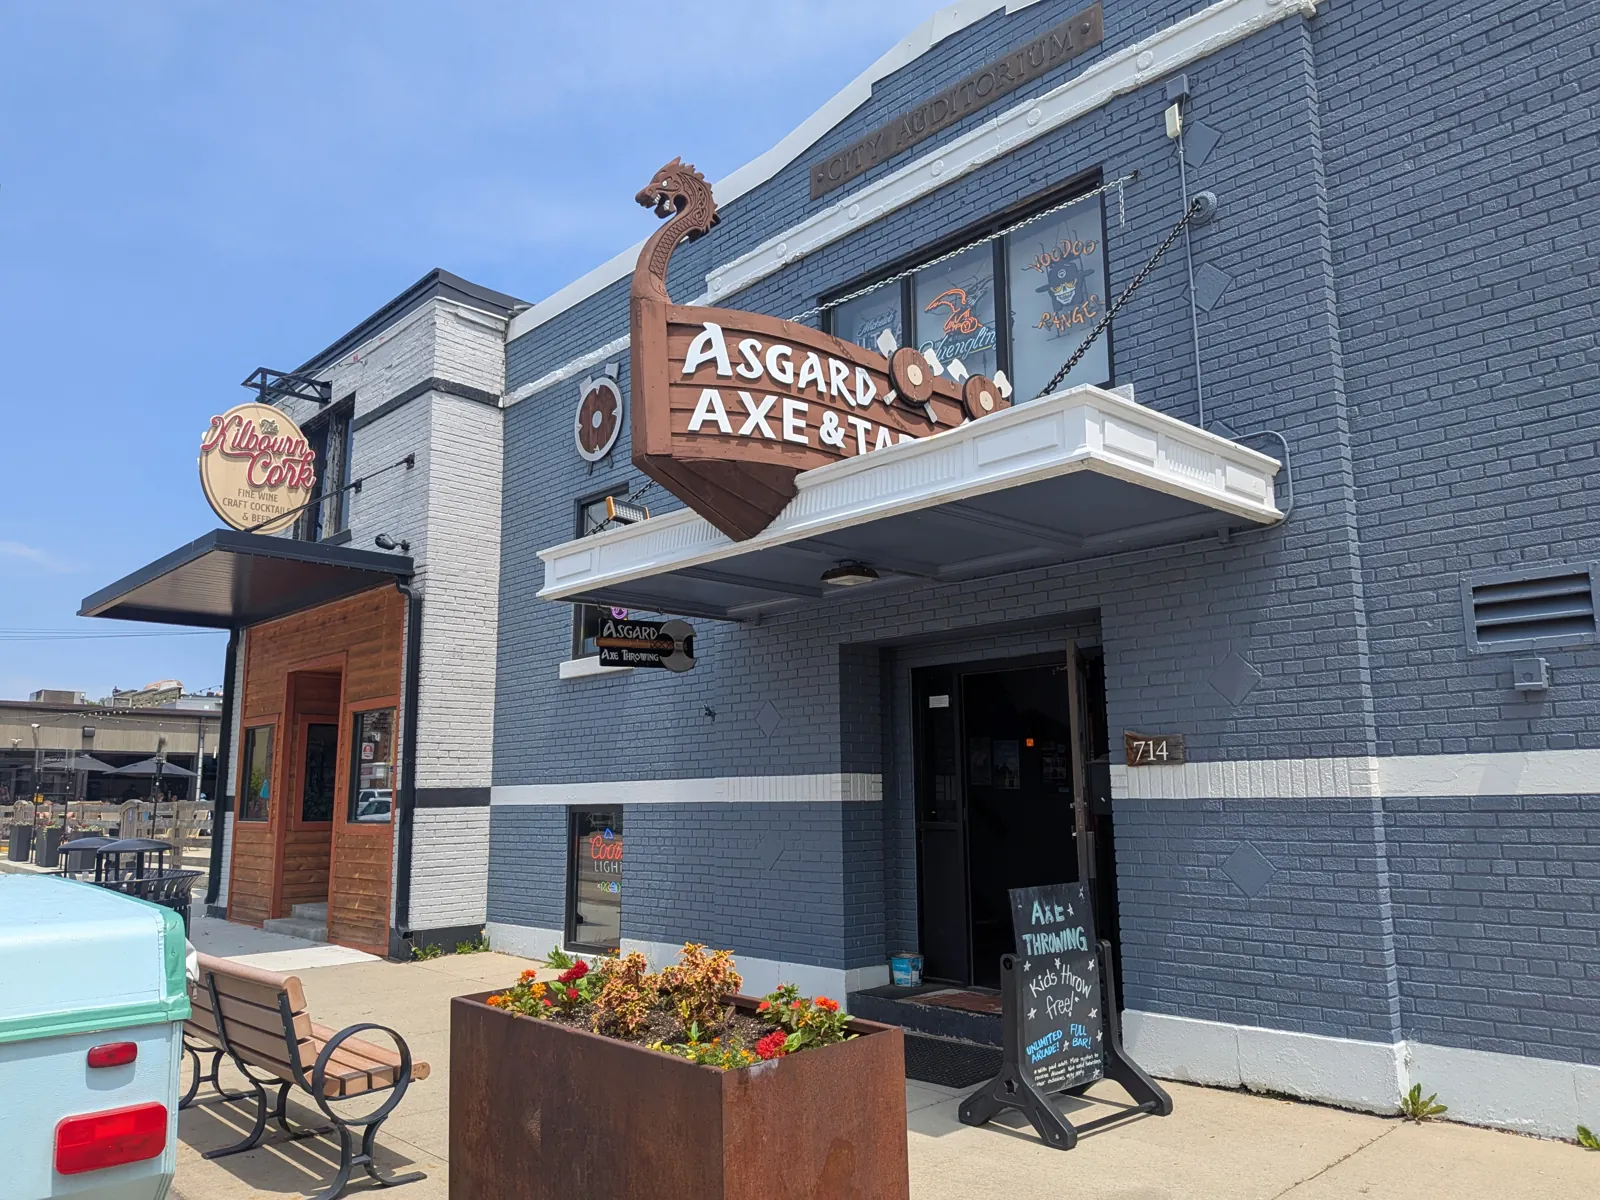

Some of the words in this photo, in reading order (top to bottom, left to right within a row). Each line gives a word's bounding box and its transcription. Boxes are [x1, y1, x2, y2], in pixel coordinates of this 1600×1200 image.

[827, 132, 883, 181] CITY
[899, 25, 1075, 144] AUDITORIUM
[1028, 240, 1097, 273] VOODOO
[1038, 294, 1105, 332] RANGER
[682, 322, 877, 407] ASGARD
[260, 418, 279, 433] The
[687, 388, 809, 444] AXE
[819, 410, 846, 449] &
[201, 414, 308, 458] Kilbourn
[247, 451, 316, 489] Cork
[222, 497, 248, 510] CRAFT
[237, 488, 255, 499] FINE
[258, 490, 279, 503] WINE
[242, 512, 249, 521] &
[602, 620, 658, 640] ASGARD
[601, 648, 619, 661] AXE
[621, 649, 659, 662] THROWING
[1133, 740, 1169, 765] 714
[1031, 899, 1065, 925] AXE
[1022, 926, 1088, 956] THROWING
[1029, 968, 1058, 998] Kids
[1061, 963, 1092, 999] throw
[1026, 1029, 1063, 1056] UNLIMITED
[1070, 1023, 1087, 1037] FULL
[1031, 1041, 1060, 1064] ARCADE!
[1072, 1037, 1092, 1050] BAR!
